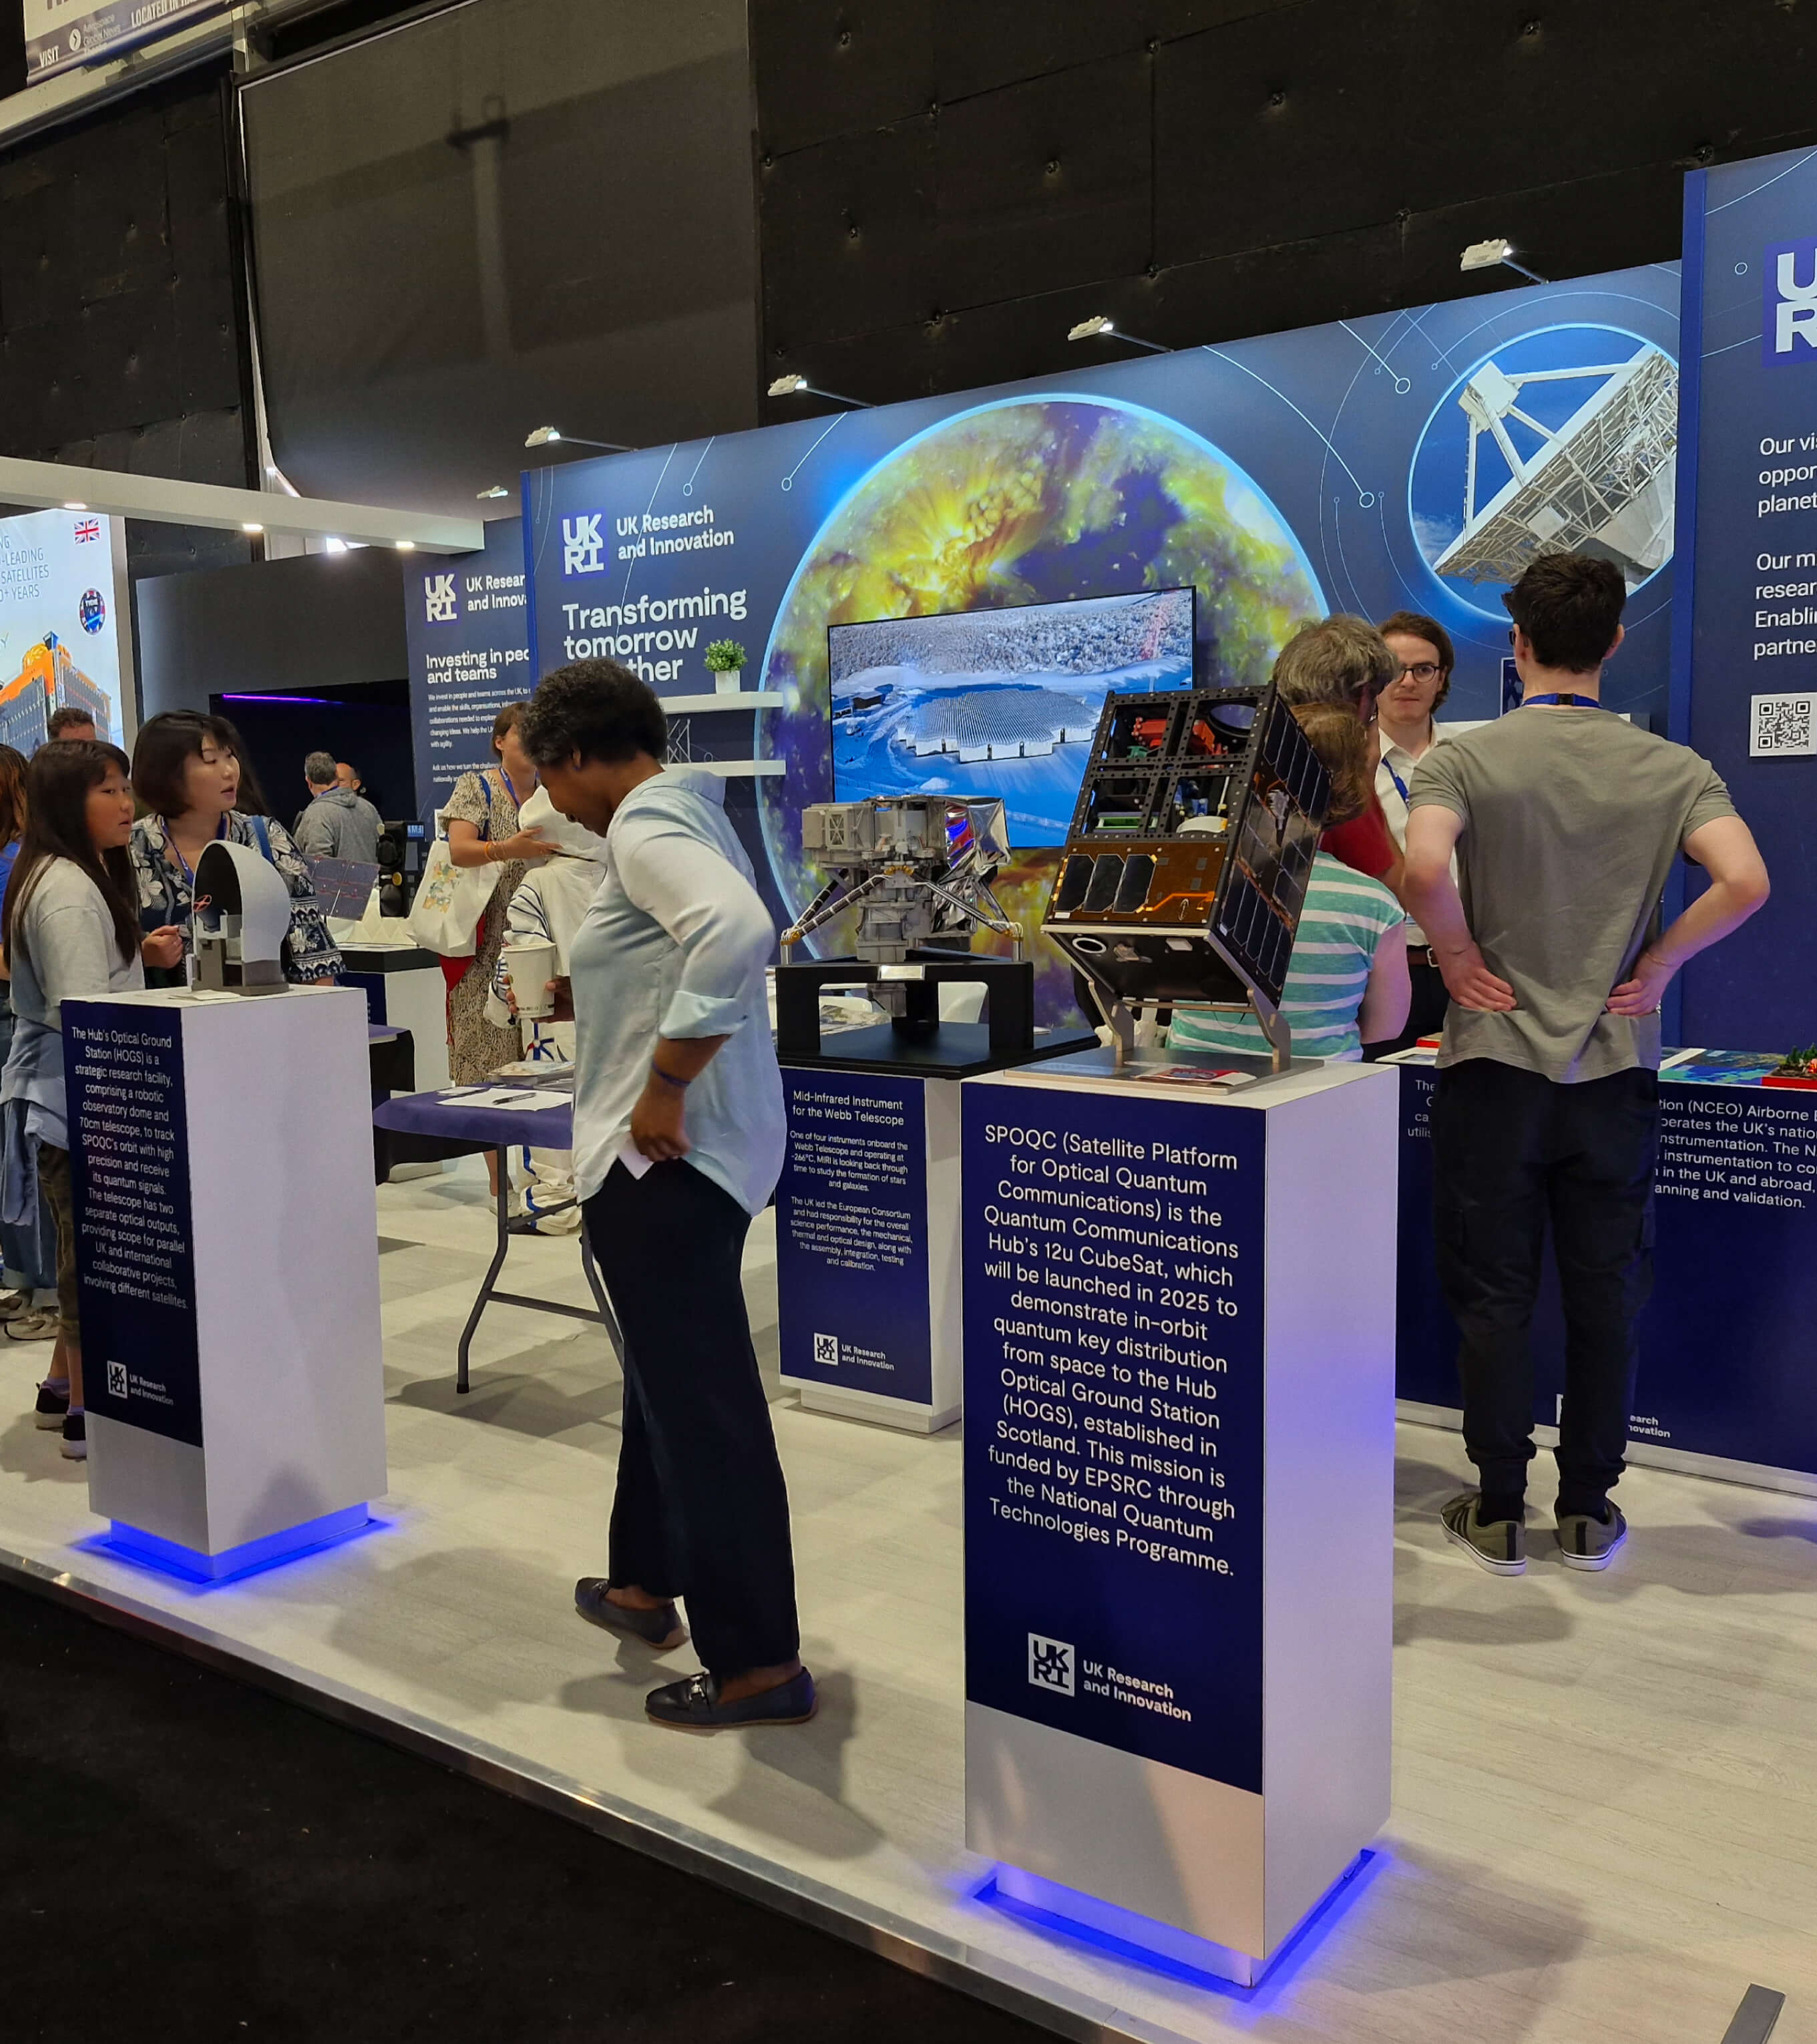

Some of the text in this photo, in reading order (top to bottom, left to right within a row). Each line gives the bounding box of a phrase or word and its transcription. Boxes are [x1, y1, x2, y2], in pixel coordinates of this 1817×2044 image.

[132, 0, 167, 27] LOCATED
[39, 46, 59, 67] VISIT
[1760, 432, 1817, 455] Our vi
[1759, 465, 1817, 487] oppor
[1758, 492, 1817, 518] planet
[616, 505, 715, 537] UK Research
[618, 529, 734, 560] and Innovation
[0, 548, 43, 566] -LEADING
[1756, 553, 1817, 571] Our m
[1, 564, 49, 584] SATELLITES
[466, 574, 525, 592] UK Resear
[11, 584, 40, 600] YEARS
[467, 594, 488, 611] and
[1756, 582, 1817, 600] resear
[562, 587, 747, 631] Transforming
[564, 627, 698, 660] tomorrow
[1754, 639, 1817, 660] partne
[426, 650, 487, 668] Investing
[489, 648, 502, 663] in
[427, 668, 497, 684] and teams
[71, 1026, 172, 1048] The Hub's Optical Ground
[85, 1045, 160, 1066] Station (HOGS) is a
[75, 1064, 173, 1088] strategic research facility,
[1415, 1079, 1436, 1092] The
[85, 1084, 164, 1103] comprising a robotic
[793, 1089, 903, 1110] Mid-Infrared Instrument
[793, 1104, 904, 1127] for the Webb Telescope
[1688, 1100, 1743, 1118] (NCEO)
[1746, 1105, 1809, 1121] Airborne
[789, 1130, 908, 1151] One of four instruments onboard the
[1715, 1120, 1738, 1133] the
[1743, 1121, 1775, 1136] UK's
[1780, 1127, 1817, 1139] natio
[794, 1142, 904, 1163] Webb Telescope and operating at
[985, 1125, 1237, 1171] SPOQC (Satellite Platform
[1772, 1141, 1800, 1155] The
[1664, 1149, 1772, 1171] instrumentation
[1776, 1161, 1792, 1172] to
[1796, 1164, 1817, 1175] co
[1010, 1154, 1207, 1196] for Optical Quantum
[1663, 1166, 1674, 1178] in
[1678, 1168, 1701, 1181] the
[1705, 1169, 1726, 1183] UK
[1730, 1174, 1756, 1186] and
[1760, 1176, 1816, 1193] abroad,
[998, 1180, 1222, 1227] Communications) is the
[1703, 1189, 1730, 1201] and
[1733, 1191, 1806, 1208] validation.
[984, 1205, 1239, 1259] Quantum Communications
[989, 1232, 1233, 1287] Hub's 12u CubeSat, which
[984, 1260, 1237, 1317] will be launched in 2025 to
[1010, 1290, 1208, 1341] demonstrate in-orbit
[841, 1344, 886, 1360] UK Research
[994, 1317, 1227, 1374] quantum key distribution
[842, 1355, 895, 1371] and Innovation
[1002, 1341, 1217, 1400] from space to the Hub
[1001, 1368, 1219, 1429] Optical Ground Station
[1004, 1393, 1217, 1458] (HOGS), established in
[996, 1420, 1225, 1488] Scotland. This mission is
[988, 1444, 1235, 1520] funded by EPSRC through
[1006, 1476, 1213, 1543] the National Quantum
[989, 1497, 1234, 1577] Technologies Programme.
[1083, 1660, 1174, 1699] UK Research
[1083, 1680, 1192, 1722] and Innovation
